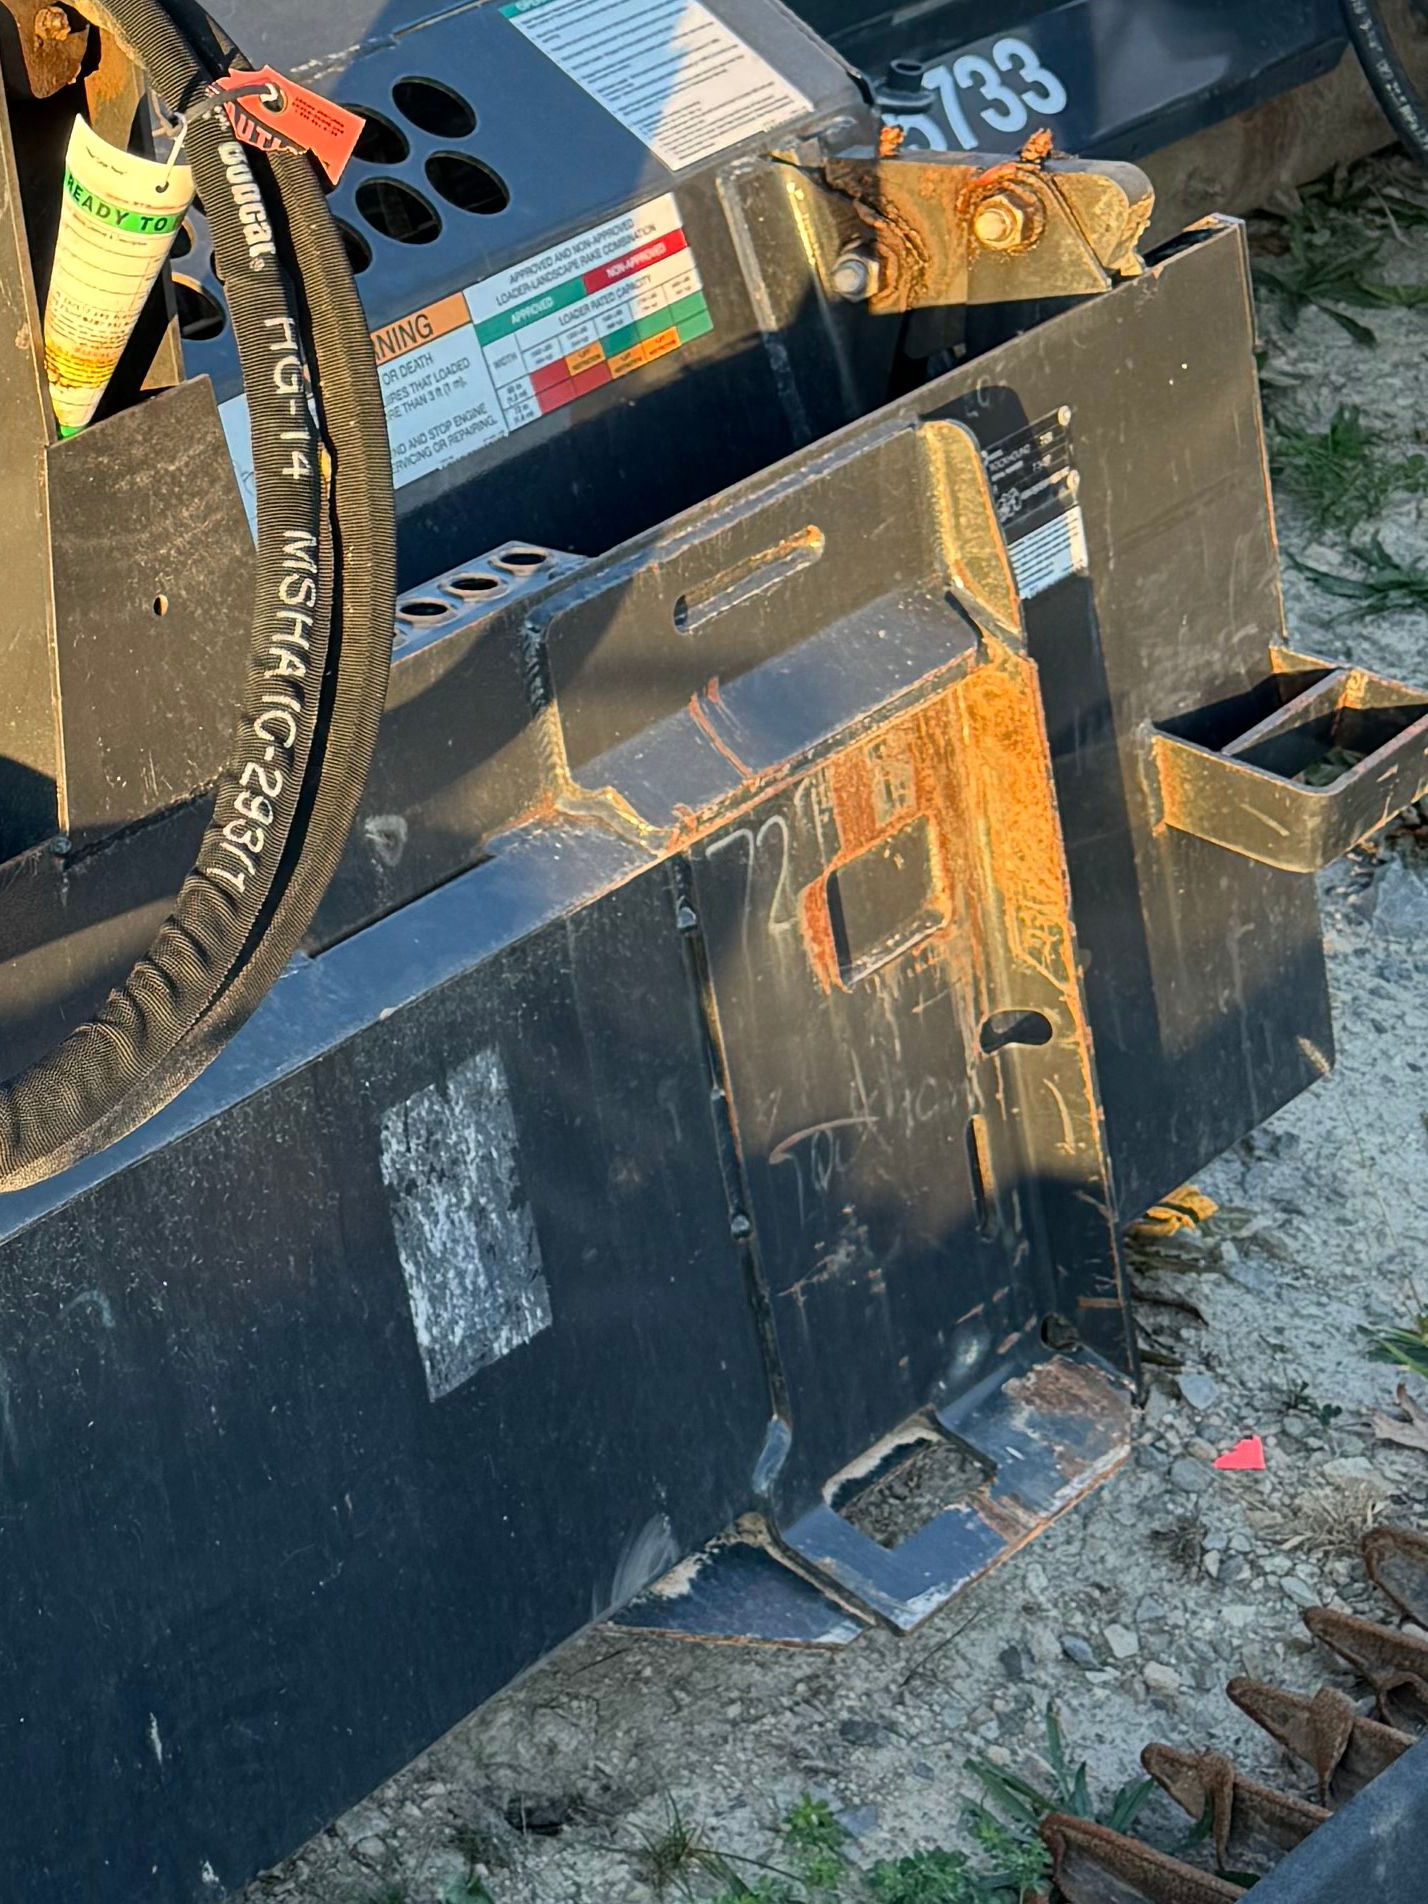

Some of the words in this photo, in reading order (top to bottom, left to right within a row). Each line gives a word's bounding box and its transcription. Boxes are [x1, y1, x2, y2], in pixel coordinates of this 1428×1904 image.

[67, 173, 129, 226] READY
[141, 216, 168, 232] TO
[510, 295, 553, 325] APPROVED
[371, 310, 433, 361] NING
[400, 351, 432, 377] DEATH
[433, 355, 470, 383] LOADED
[264, 318, 311, 480] HG-14
[429, 418, 453, 439] STOP
[454, 402, 486, 427] ENGINE
[264, 530, 317, 678] MSHA
